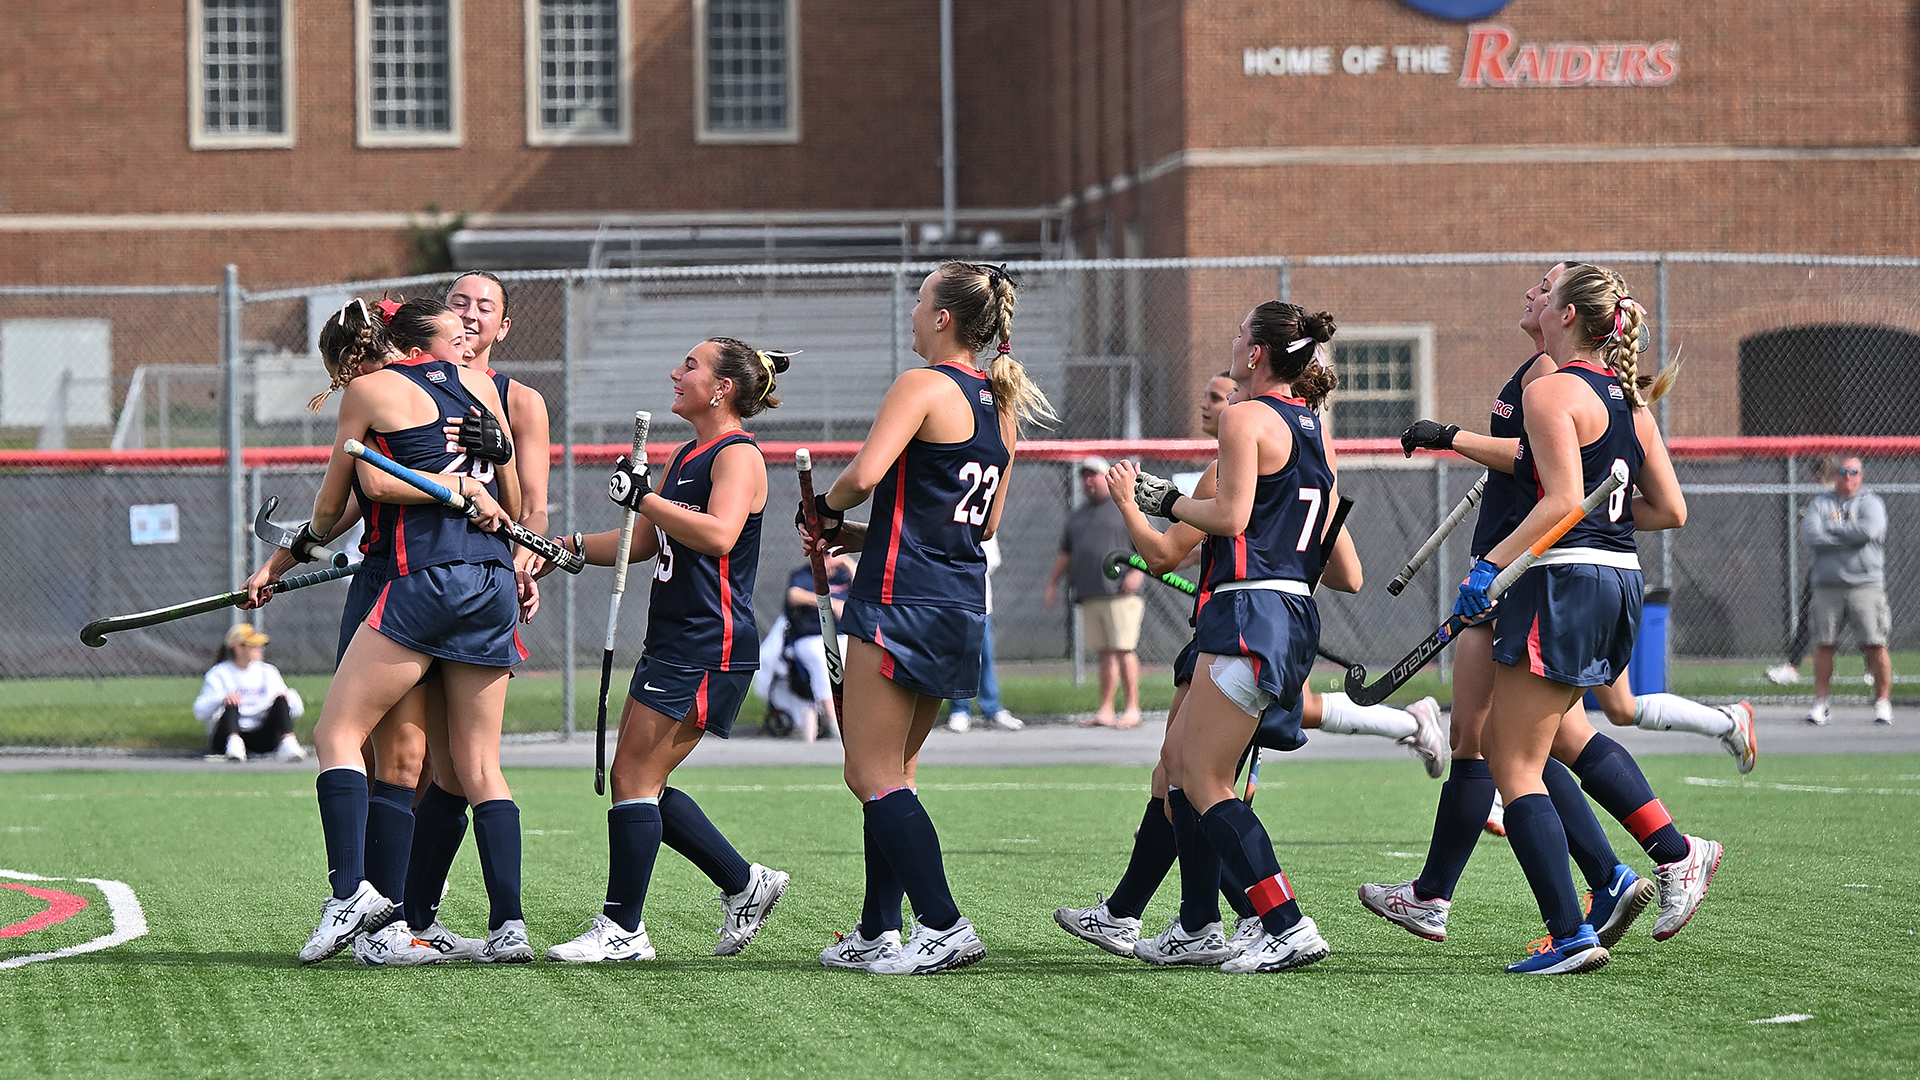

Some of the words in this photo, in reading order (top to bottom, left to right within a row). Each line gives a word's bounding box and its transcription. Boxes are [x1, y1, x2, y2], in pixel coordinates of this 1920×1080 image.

[1243, 46, 1332, 76] HOME
[1342, 45, 1386, 75] OF
[1391, 45, 1451, 74] THE
[1458, 24, 1680, 87] RAIDERS
[952, 461, 1000, 527] 23
[1295, 487, 1321, 552] 7
[1608, 457, 1630, 523] 8
[653, 525, 674, 583] 5
